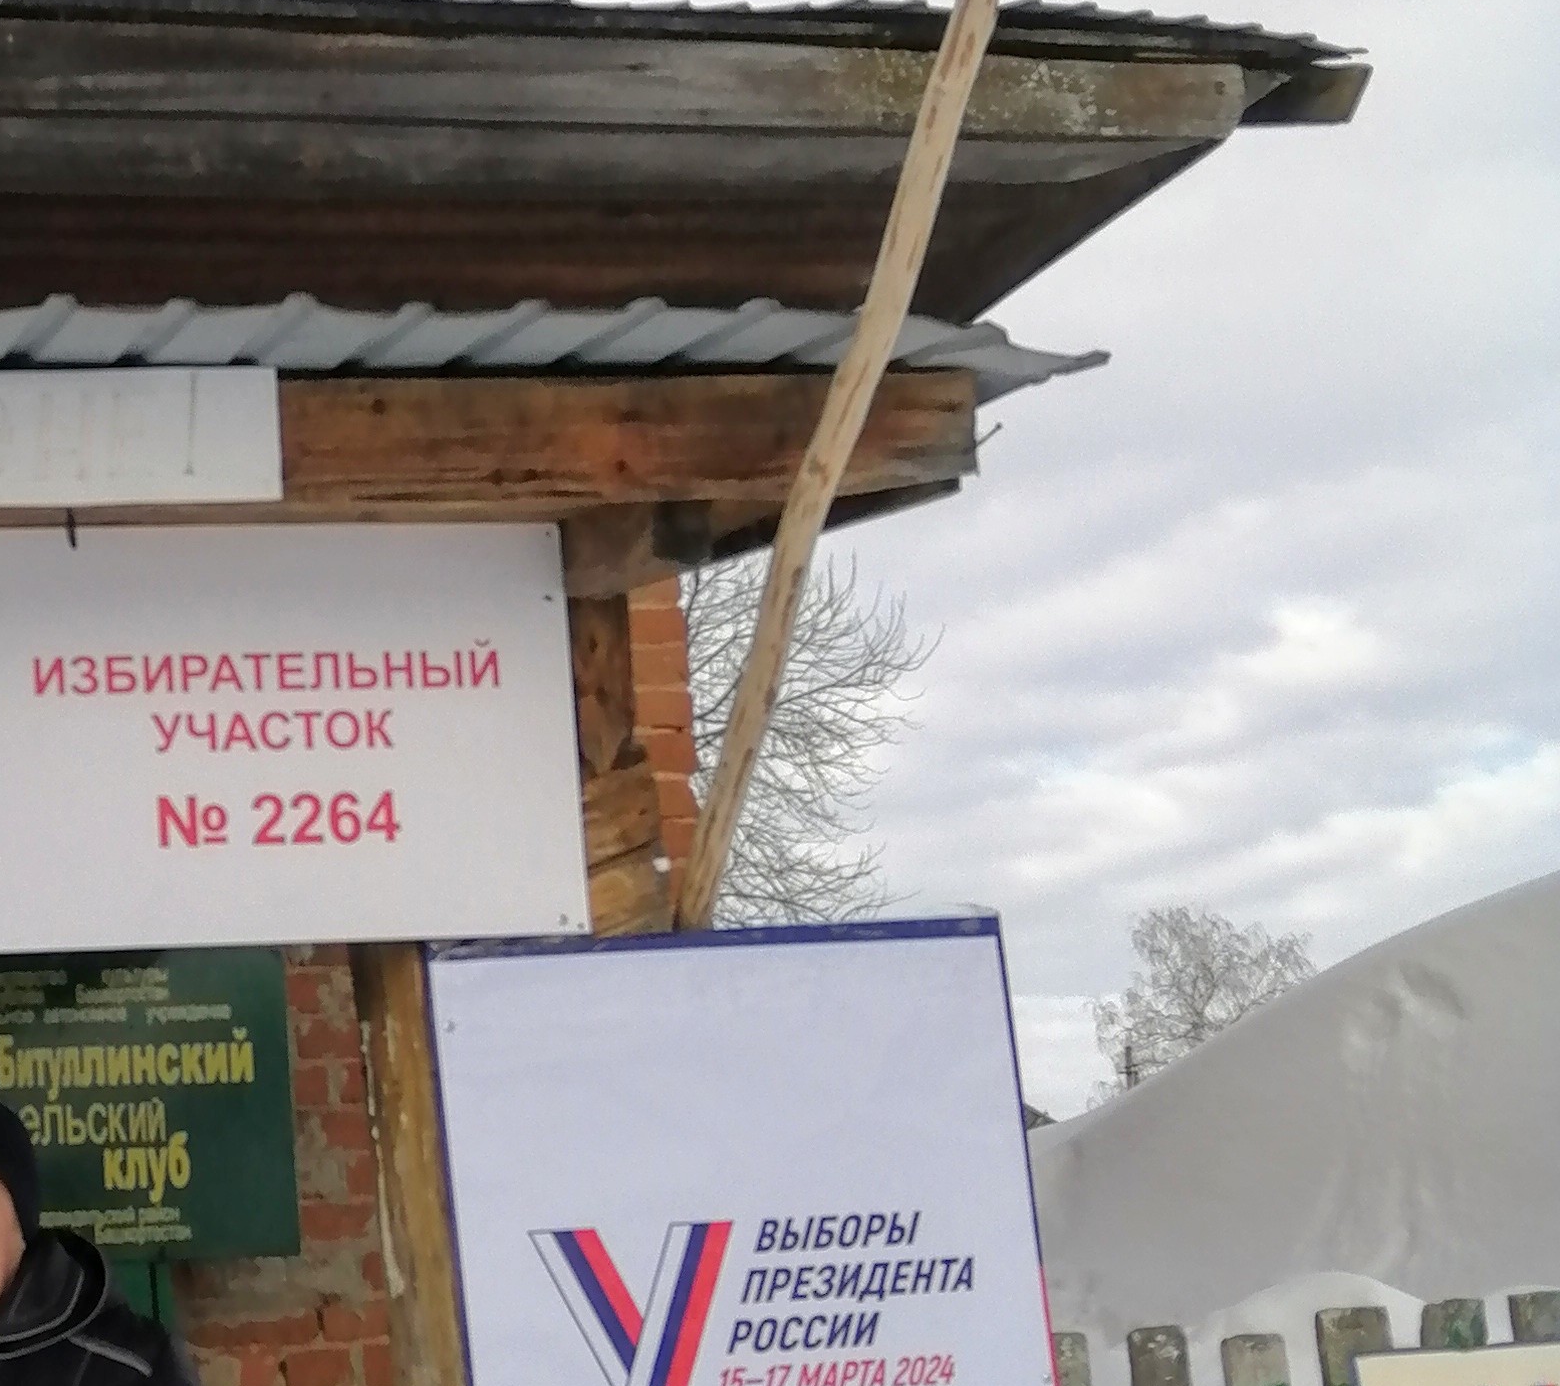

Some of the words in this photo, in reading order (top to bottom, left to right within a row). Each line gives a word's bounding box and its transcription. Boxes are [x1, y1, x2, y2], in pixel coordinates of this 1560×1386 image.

[33, 639, 501, 695] ИЗБИРАТЕЛЬНЫЙ
[152, 710, 394, 753] УЧАСТОК
[157, 795, 228, 848] №
[252, 790, 401, 846] 2264
[18, 1097, 167, 1147] ельский
[102, 1131, 191, 1204] клуб
[754, 1211, 922, 1254] ВЫБОРЫ
[740, 1257, 975, 1303] ПРЕЗИДЕНТА
[727, 1312, 880, 1355] РОССИИ
